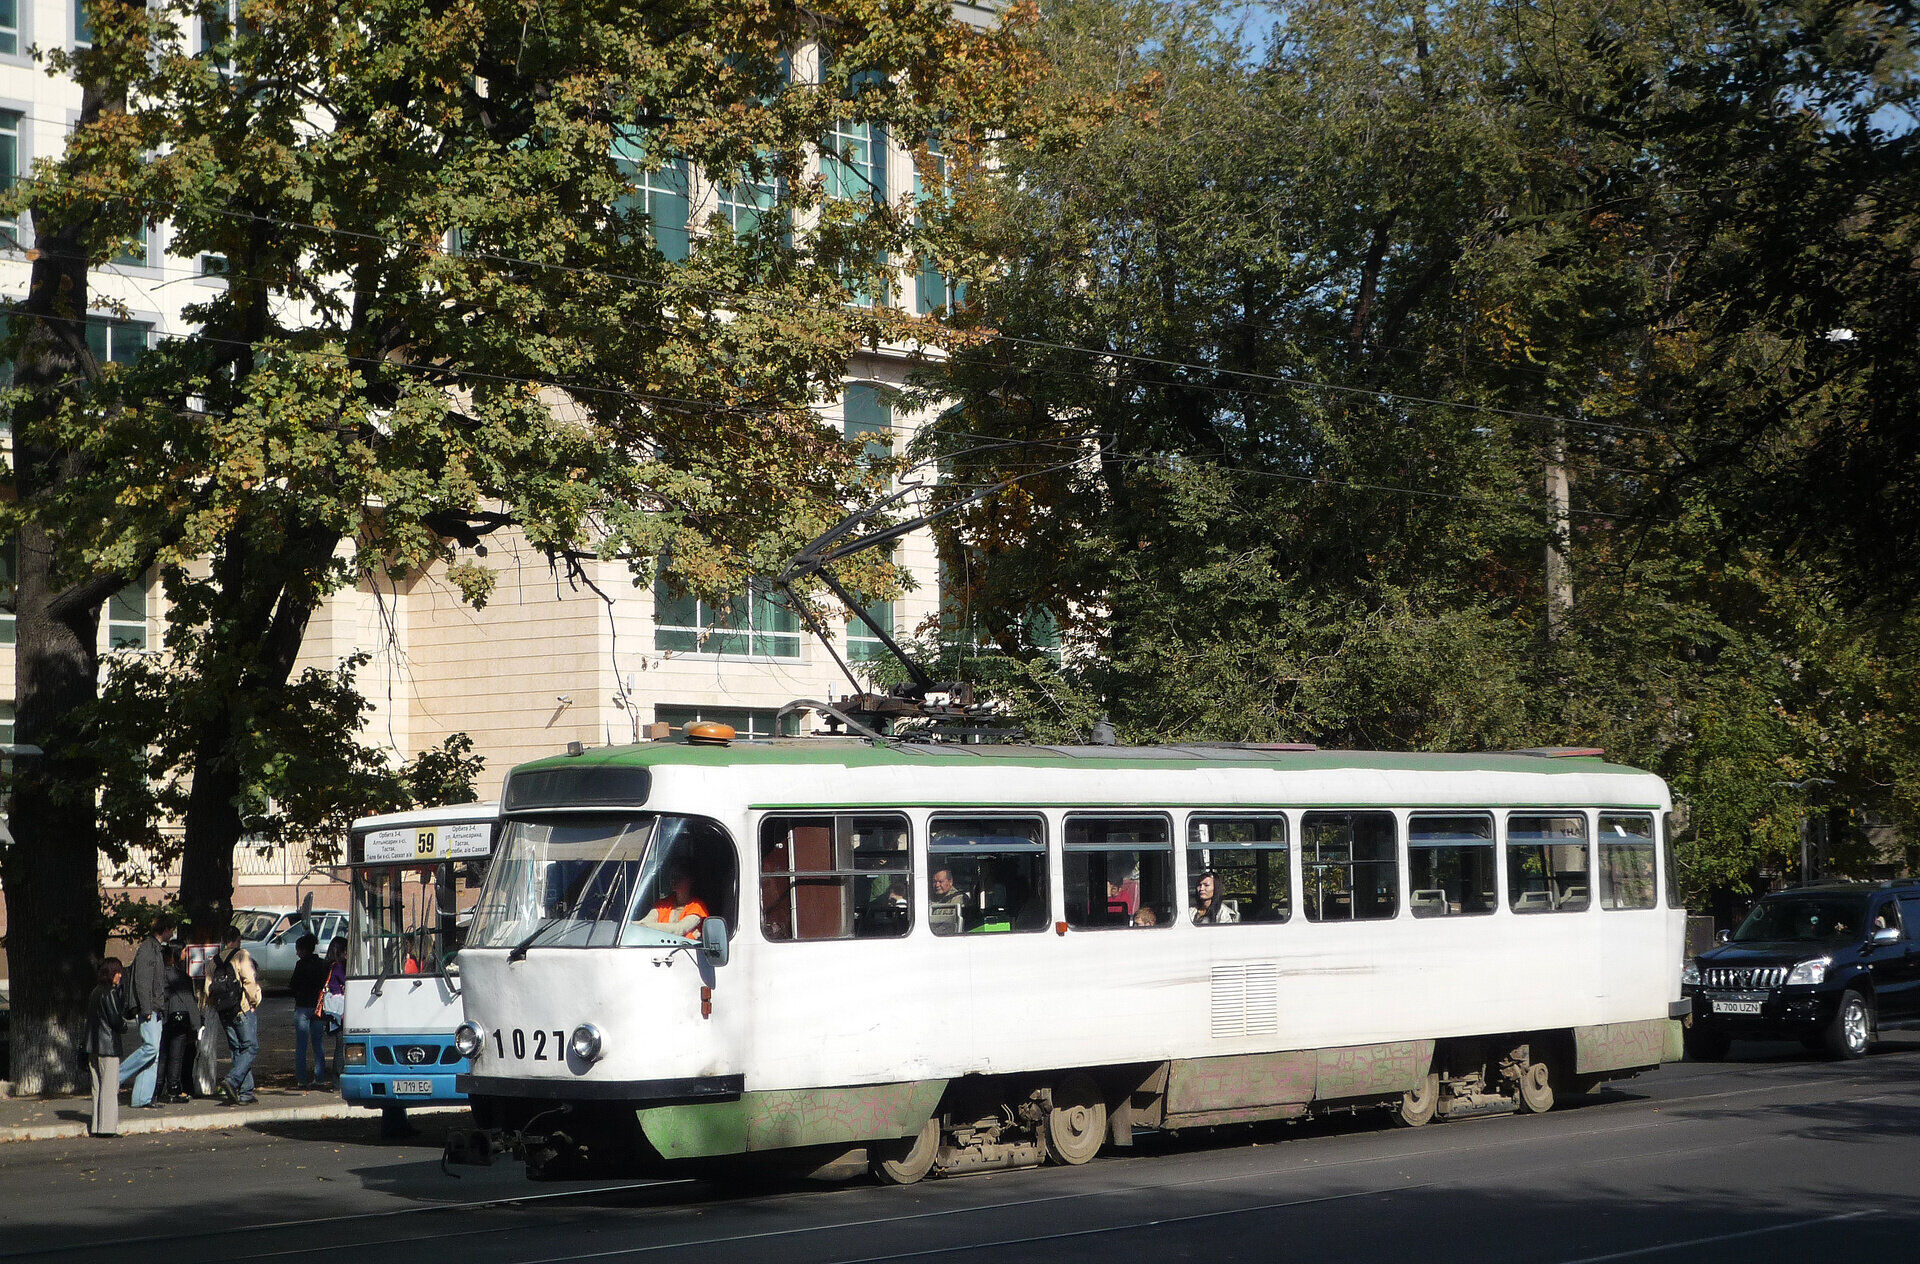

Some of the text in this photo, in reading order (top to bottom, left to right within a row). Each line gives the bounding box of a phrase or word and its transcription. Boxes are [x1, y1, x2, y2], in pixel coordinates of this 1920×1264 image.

[418, 832, 434, 853] 59
[1716, 1003, 1758, 1012] A 700 UZN
[493, 1028, 565, 1061] 1027
[396, 1081, 429, 1092] A 719 EC
